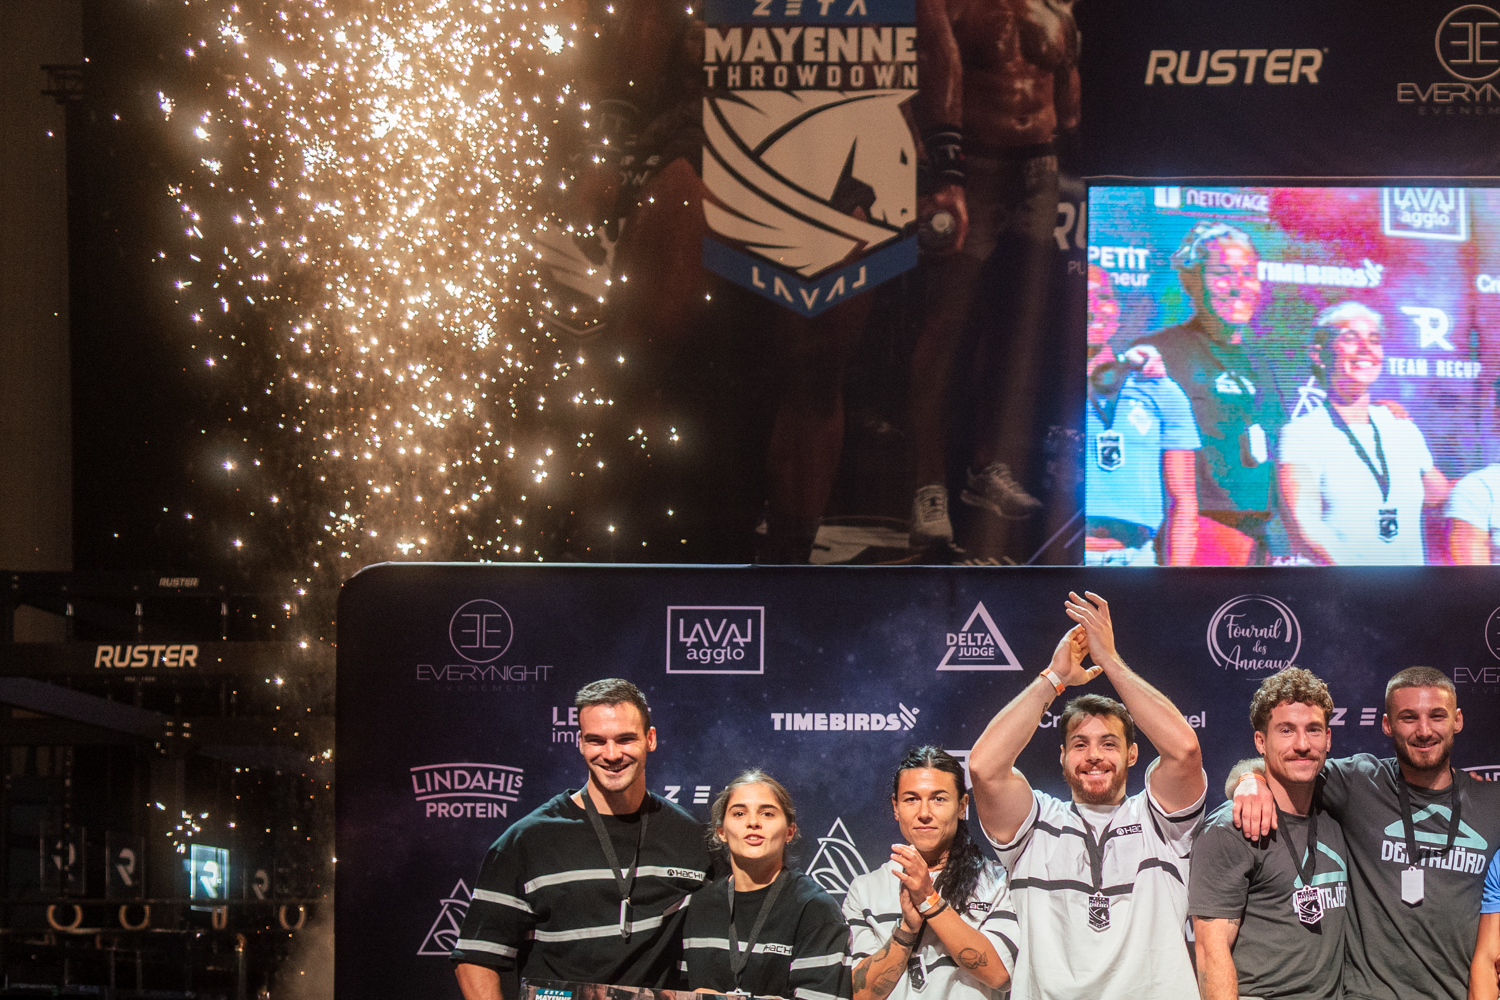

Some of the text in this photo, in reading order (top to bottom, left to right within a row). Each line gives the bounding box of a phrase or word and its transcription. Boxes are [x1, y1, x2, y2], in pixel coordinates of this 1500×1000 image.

[704, 26, 917, 63] MAYENNE
[704, 65, 918, 88] THROWDOWN
[1400, 209, 1451, 231] agglo
[1389, 357, 1429, 377] TEAM
[159, 577, 199, 587] RUSTER
[1224, 613, 1283, 640] Fournil
[946, 633, 994, 647] DELTA
[1252, 640, 1267, 655] des
[94, 644, 199, 668] RUSTER
[687, 645, 745, 665] agglo
[958, 647, 994, 657] JUDGE
[416, 664, 553, 681] EVERYNIGHT
[771, 713, 902, 731] TIMEBIRDS
[426, 802, 508, 819] PROTEIN
